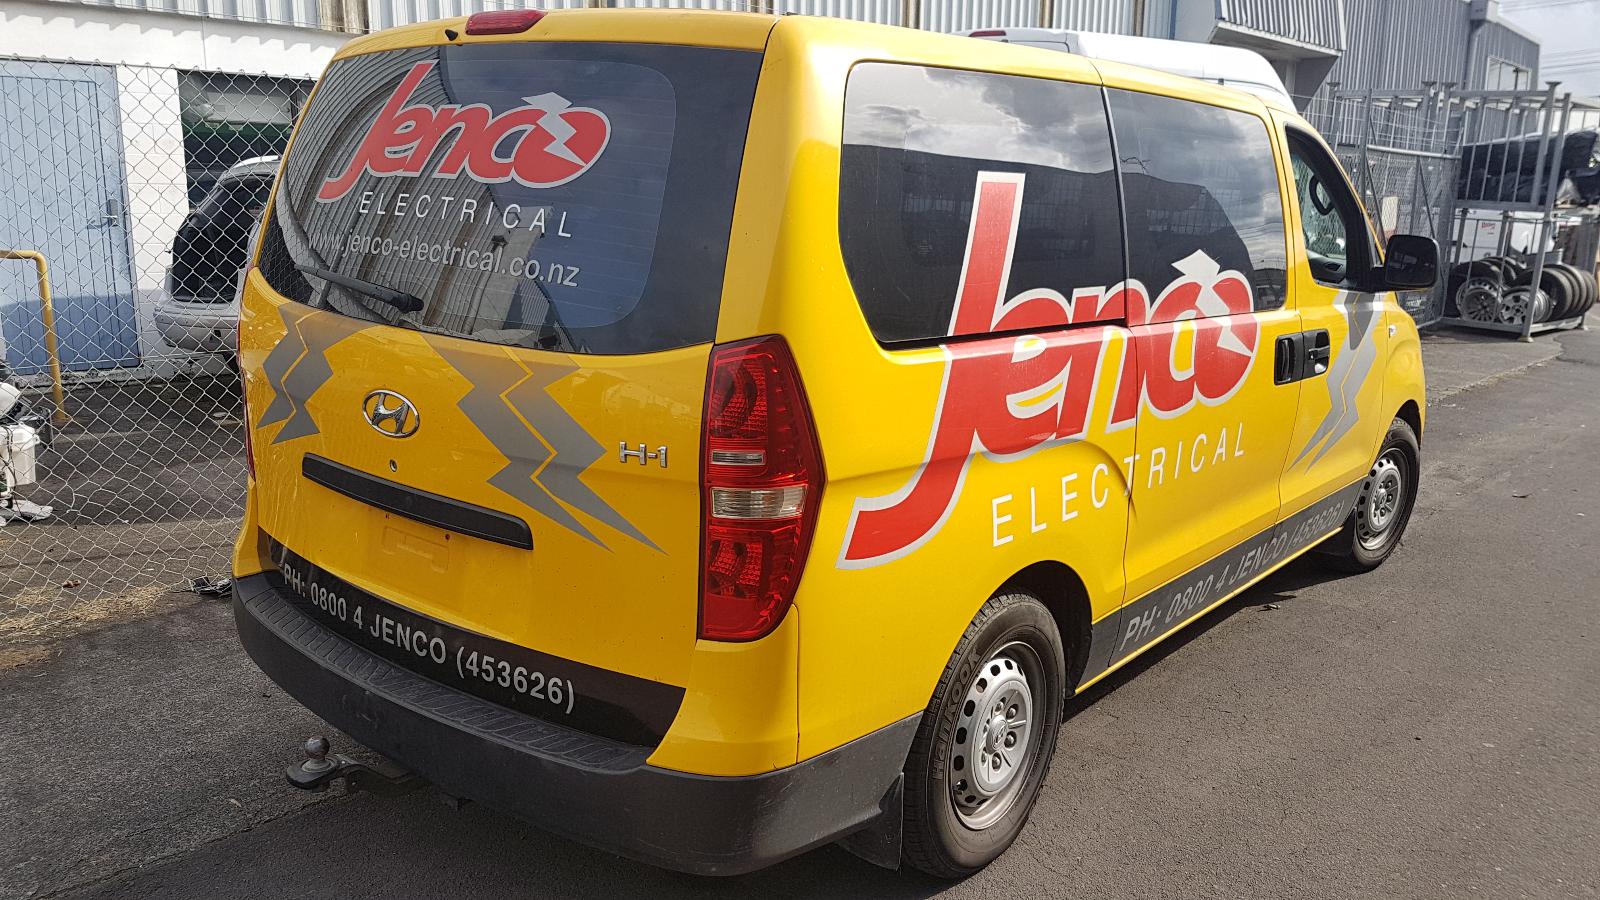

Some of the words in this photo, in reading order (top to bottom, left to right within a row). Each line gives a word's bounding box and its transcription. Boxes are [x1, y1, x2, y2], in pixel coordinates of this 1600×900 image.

[314, 59, 612, 203] Jenco
[309, 231, 581, 288] www.jenco-electrical.co.nz
[359, 191, 572, 239] ELECTRICAL
[834, 170, 1261, 570] Jenco
[619, 441, 667, 468] H-1
[991, 422, 1246, 547] ELECTRICAL
[283, 563, 306, 598] PH:
[310, 582, 347, 622] 0800
[353, 605, 363, 630] 4
[370, 614, 447, 664] JENCO
[456, 645, 576, 714] (453626)
[1119, 604, 1162, 651] PH:
[1164, 574, 1214, 624] 0800
[1215, 563, 1230, 593] 4
[1228, 532, 1288, 586] JENCO
[1284, 499, 1345, 557] (453626)
